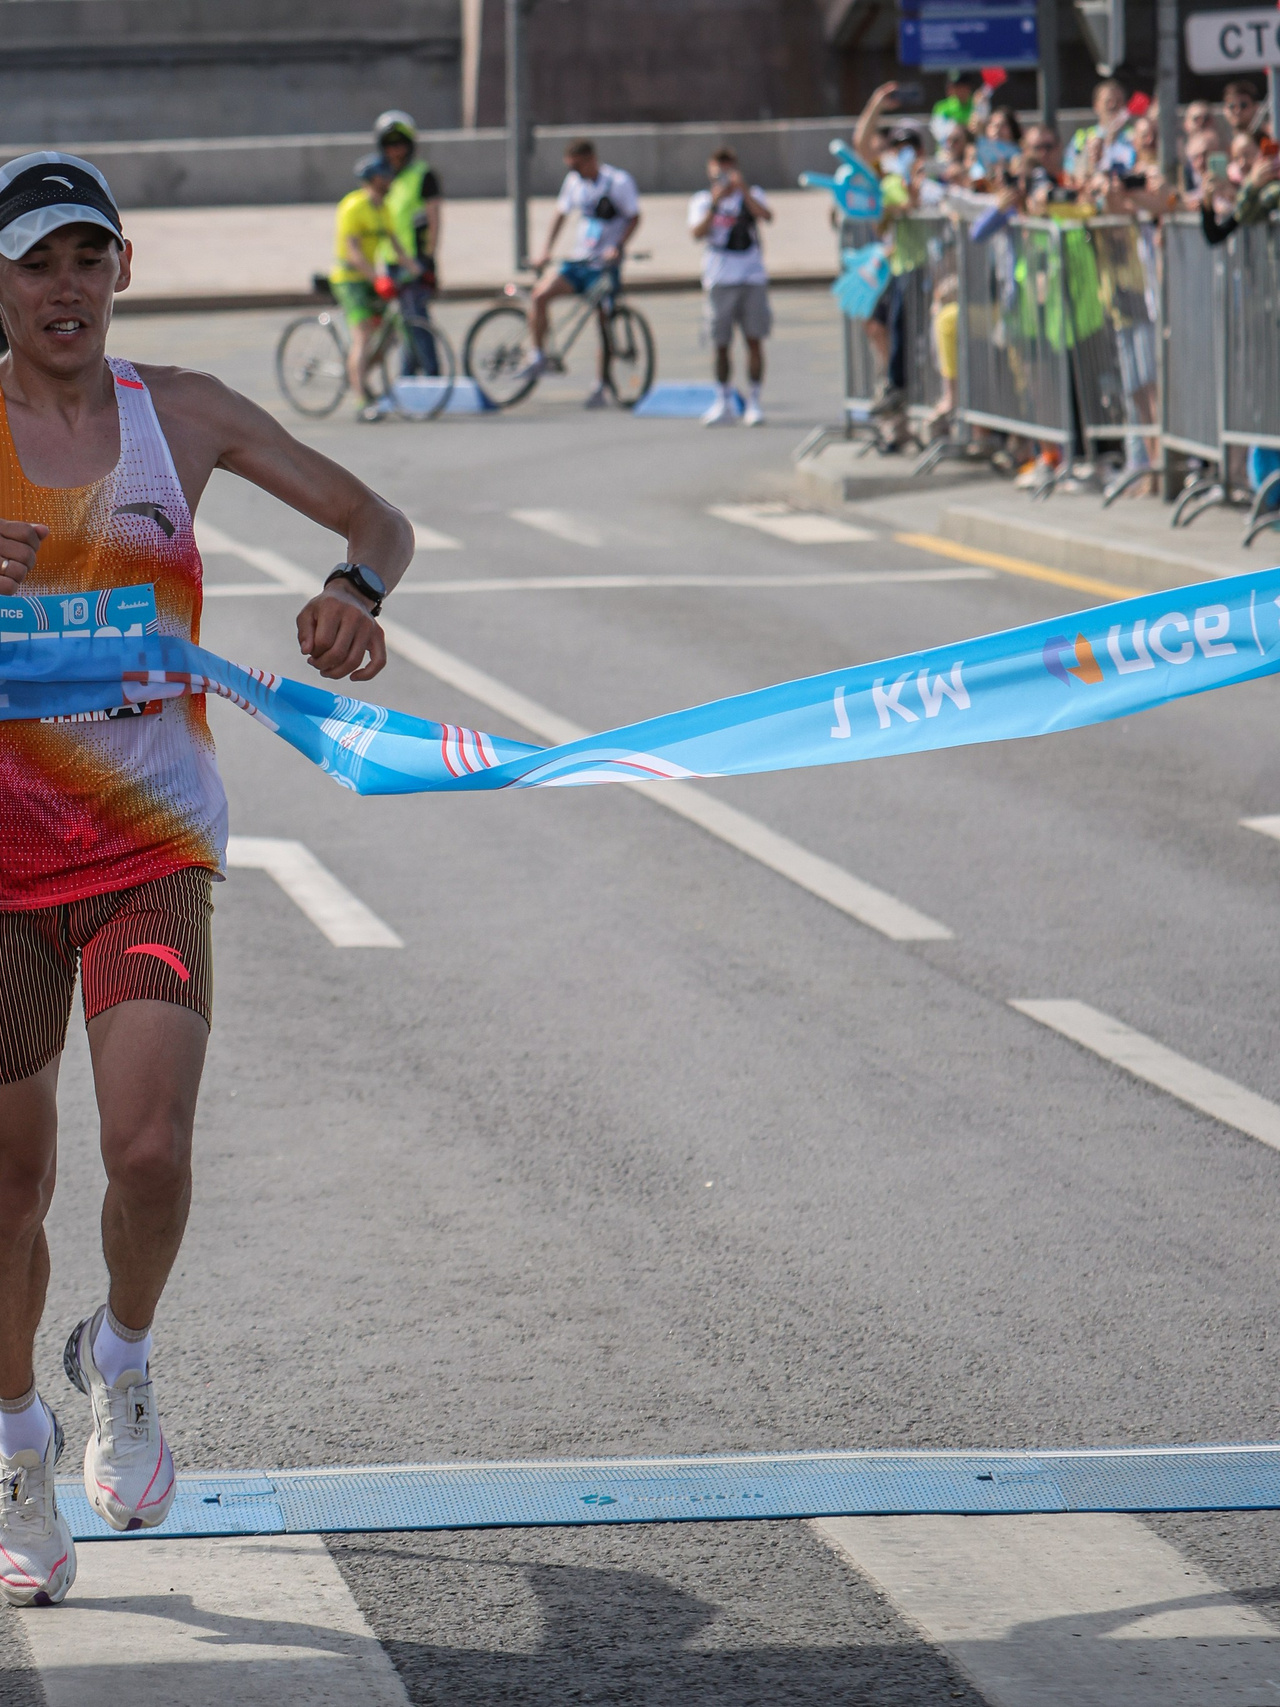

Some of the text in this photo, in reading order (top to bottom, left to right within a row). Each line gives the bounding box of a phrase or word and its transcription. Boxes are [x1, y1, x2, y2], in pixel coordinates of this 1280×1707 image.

[1219, 20, 1280, 60] СТ
[0, 606, 24, 619] ПСБ
[59, 597, 89, 626] 10
